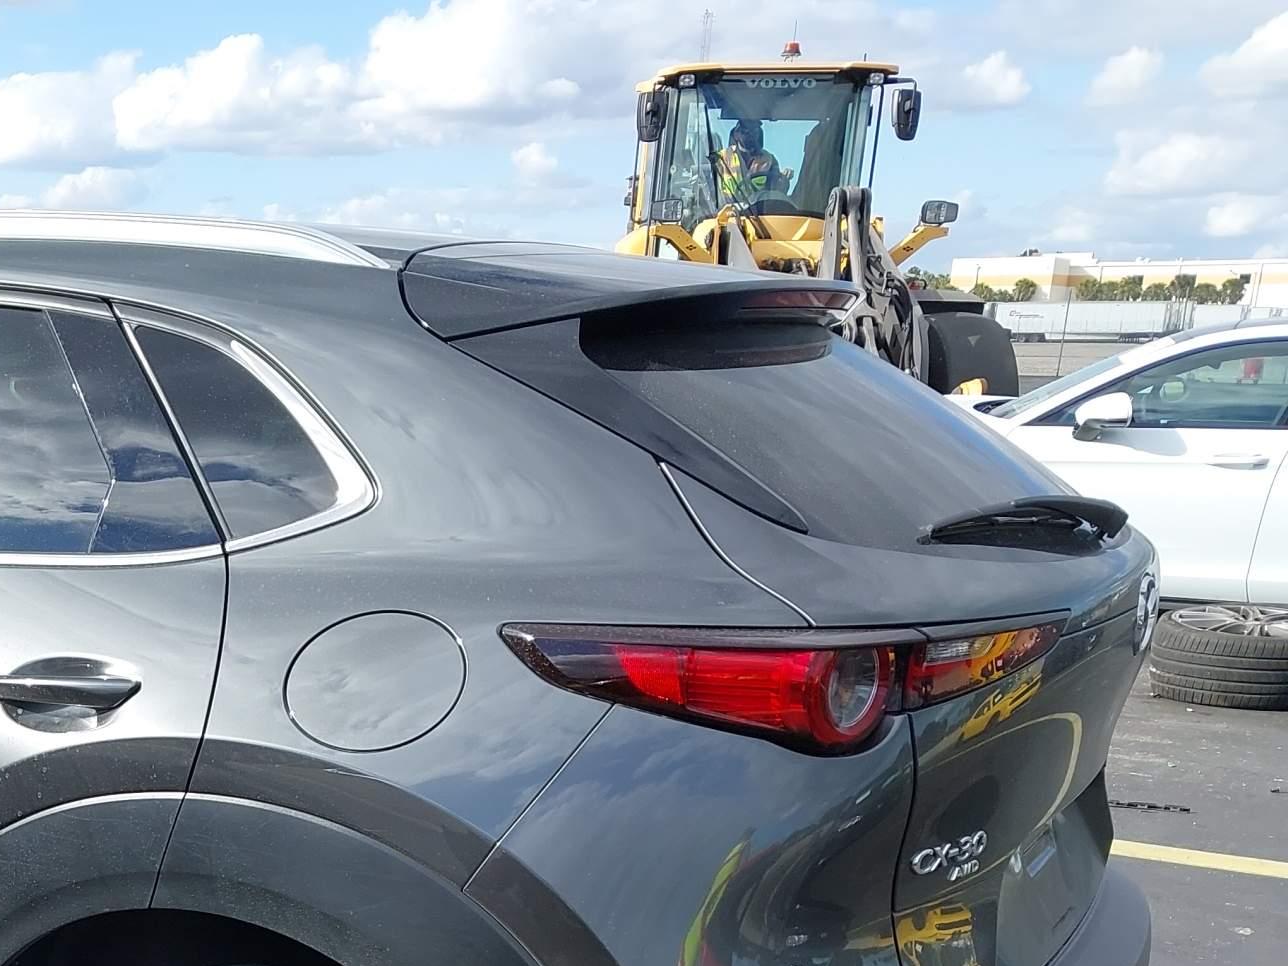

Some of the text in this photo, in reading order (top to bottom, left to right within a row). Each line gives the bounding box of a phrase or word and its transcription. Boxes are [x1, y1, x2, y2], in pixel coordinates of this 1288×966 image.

[744, 78, 817, 89] VOLVO
[912, 830, 988, 875] CX-30
[947, 859, 981, 881] AWD
